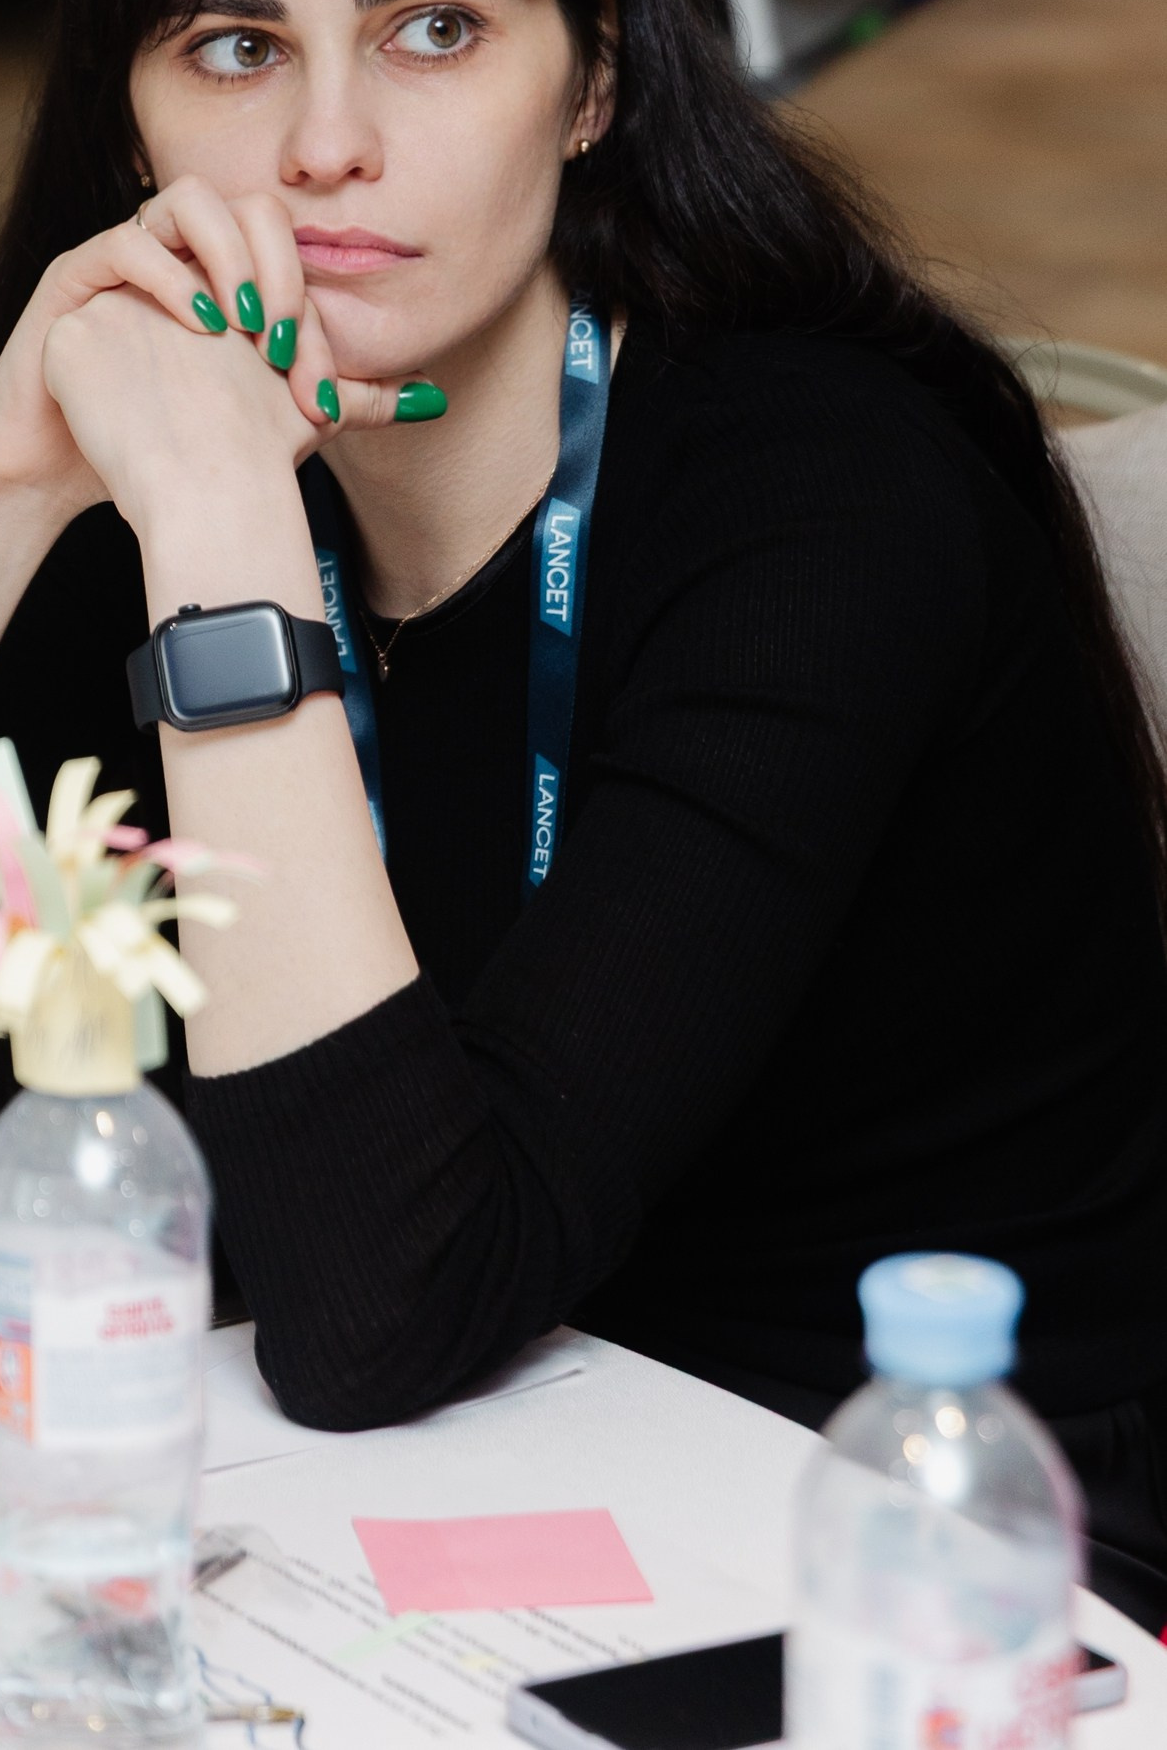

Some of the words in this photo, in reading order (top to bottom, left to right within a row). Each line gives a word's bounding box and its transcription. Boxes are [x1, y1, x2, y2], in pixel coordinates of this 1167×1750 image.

[570, 288, 595, 370] ANCET
[546, 515, 575, 623] LANCET
[533, 773, 555, 880] LANCET
